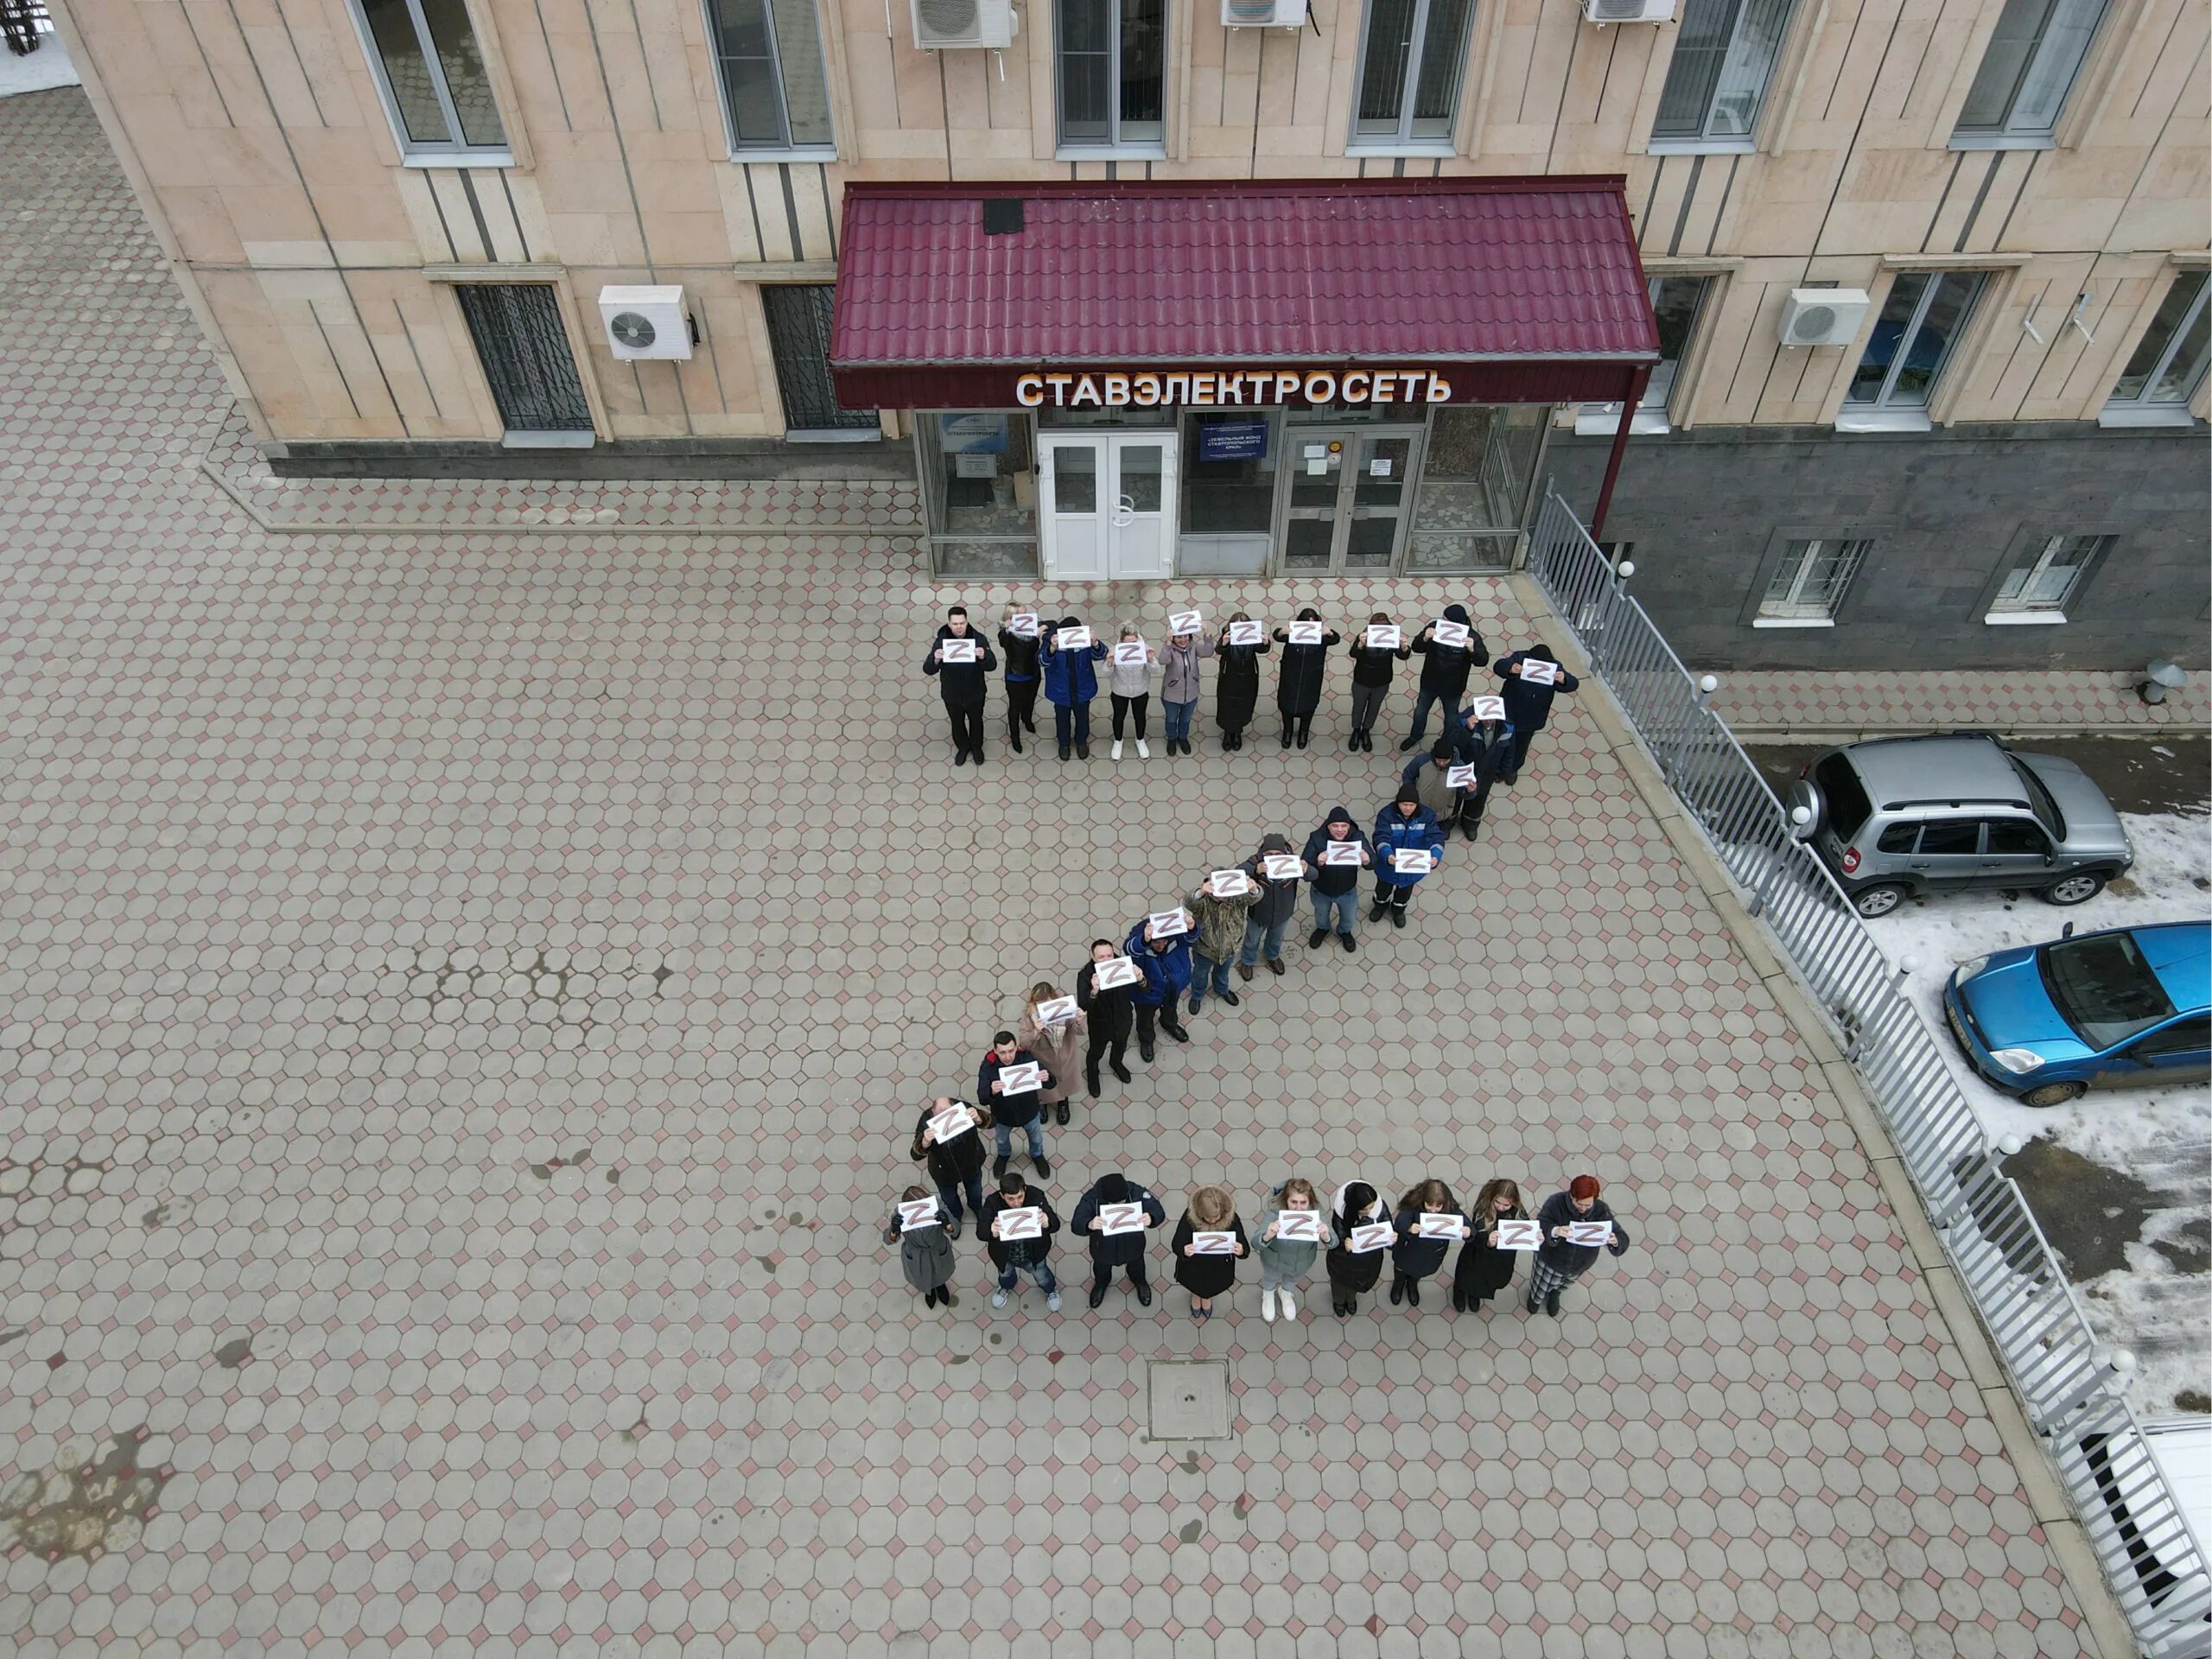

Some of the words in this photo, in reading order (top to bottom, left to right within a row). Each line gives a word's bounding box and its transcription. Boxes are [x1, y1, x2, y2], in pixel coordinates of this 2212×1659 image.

[1016, 371, 1452, 406] СТАВЭЛЕКТРОСЕТЬ
[1014, 616, 1034, 632] Z
[1173, 613, 1199, 632] Z
[1294, 623, 1318, 640] Z
[1063, 628, 1086, 645] Z
[1234, 624, 1257, 642] Z
[1372, 627, 1395, 644] Z
[1440, 624, 1463, 642] Z
[947, 641, 971, 659] Z
[1120, 645, 1142, 662] Z
[1526, 663, 1551, 682] Z
[1478, 699, 1499, 716] Z
[1452, 767, 1472, 784] Z
[1331, 844, 1357, 861] Z
[1401, 852, 1427, 869] Z
[1269, 857, 1298, 874] Z
[1215, 873, 1245, 893] Z
[1154, 913, 1182, 933] Z
[1101, 961, 1131, 984] Z
[1043, 1001, 1074, 1022] Z
[1004, 1067, 1038, 1090] Z
[933, 1109, 968, 1136] Z
[901, 1203, 935, 1226] Z
[1002, 1211, 1037, 1235] Z
[1105, 1207, 1138, 1230] Z
[1283, 1214, 1315, 1236] Z
[1424, 1217, 1457, 1236] Z
[1503, 1224, 1535, 1245] Z
[1574, 1224, 1605, 1243] Z
[1198, 1235, 1231, 1251] Z
[1357, 1227, 1387, 1249] Z
